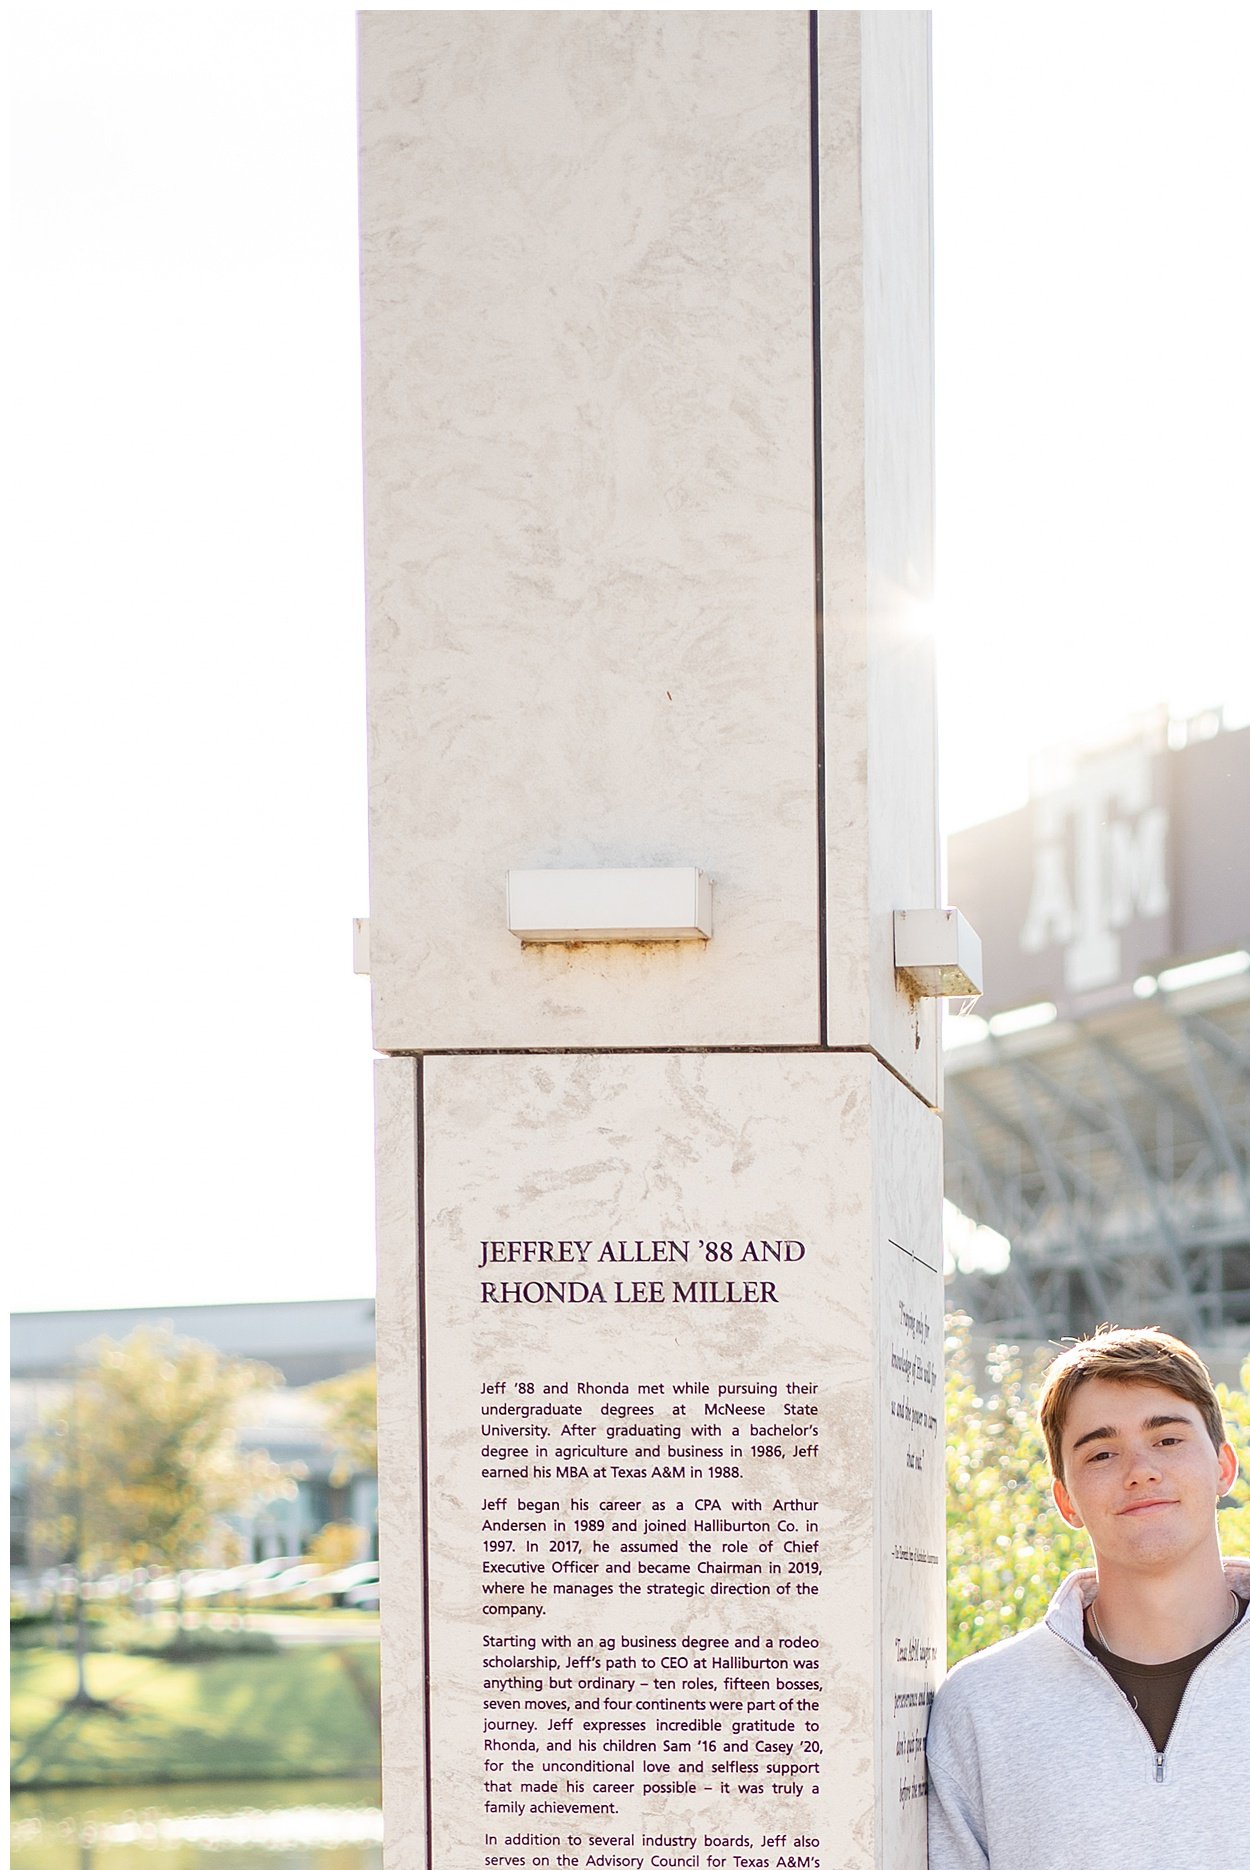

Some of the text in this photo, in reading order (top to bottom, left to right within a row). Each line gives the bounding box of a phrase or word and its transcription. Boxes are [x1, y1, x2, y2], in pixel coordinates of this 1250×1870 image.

[478, 1240, 805, 1268] JEFFREY ALLEN '88 AND
[480, 1281, 779, 1304] RHONDA LEE MILLER
[480, 1381, 818, 1398] Jeff '88 and Rhonda met while pursuing their
[481, 1402, 818, 1419] undergraduate degrees at McNeese State
[481, 1423, 818, 1440] University. After graduating with a bachelor's
[481, 1444, 819, 1460] degree in agriculture and business in 1986, Jeff
[481, 1465, 743, 1478] earned his MBA at Texas A&M in 1988.
[481, 1498, 819, 1514] Jeff began his career as a CPA with Arthur
[481, 1518, 818, 1535] Andersen in 1989 and joined Halliburton Co. in
[483, 1540, 819, 1554] 1997. In 2017, he assumed the role of Chief
[482, 1560, 822, 1576] Executive Officer and became Chairman in 2019,
[482, 1581, 819, 1598] where he manages the strategic direction of the
[482, 1605, 546, 1618] company.
[482, 1634, 819, 1651] Starting with an ag business degree and a rodeo
[482, 1655, 820, 1672] scholarship, Jeff's path to CEO at Halliburton was
